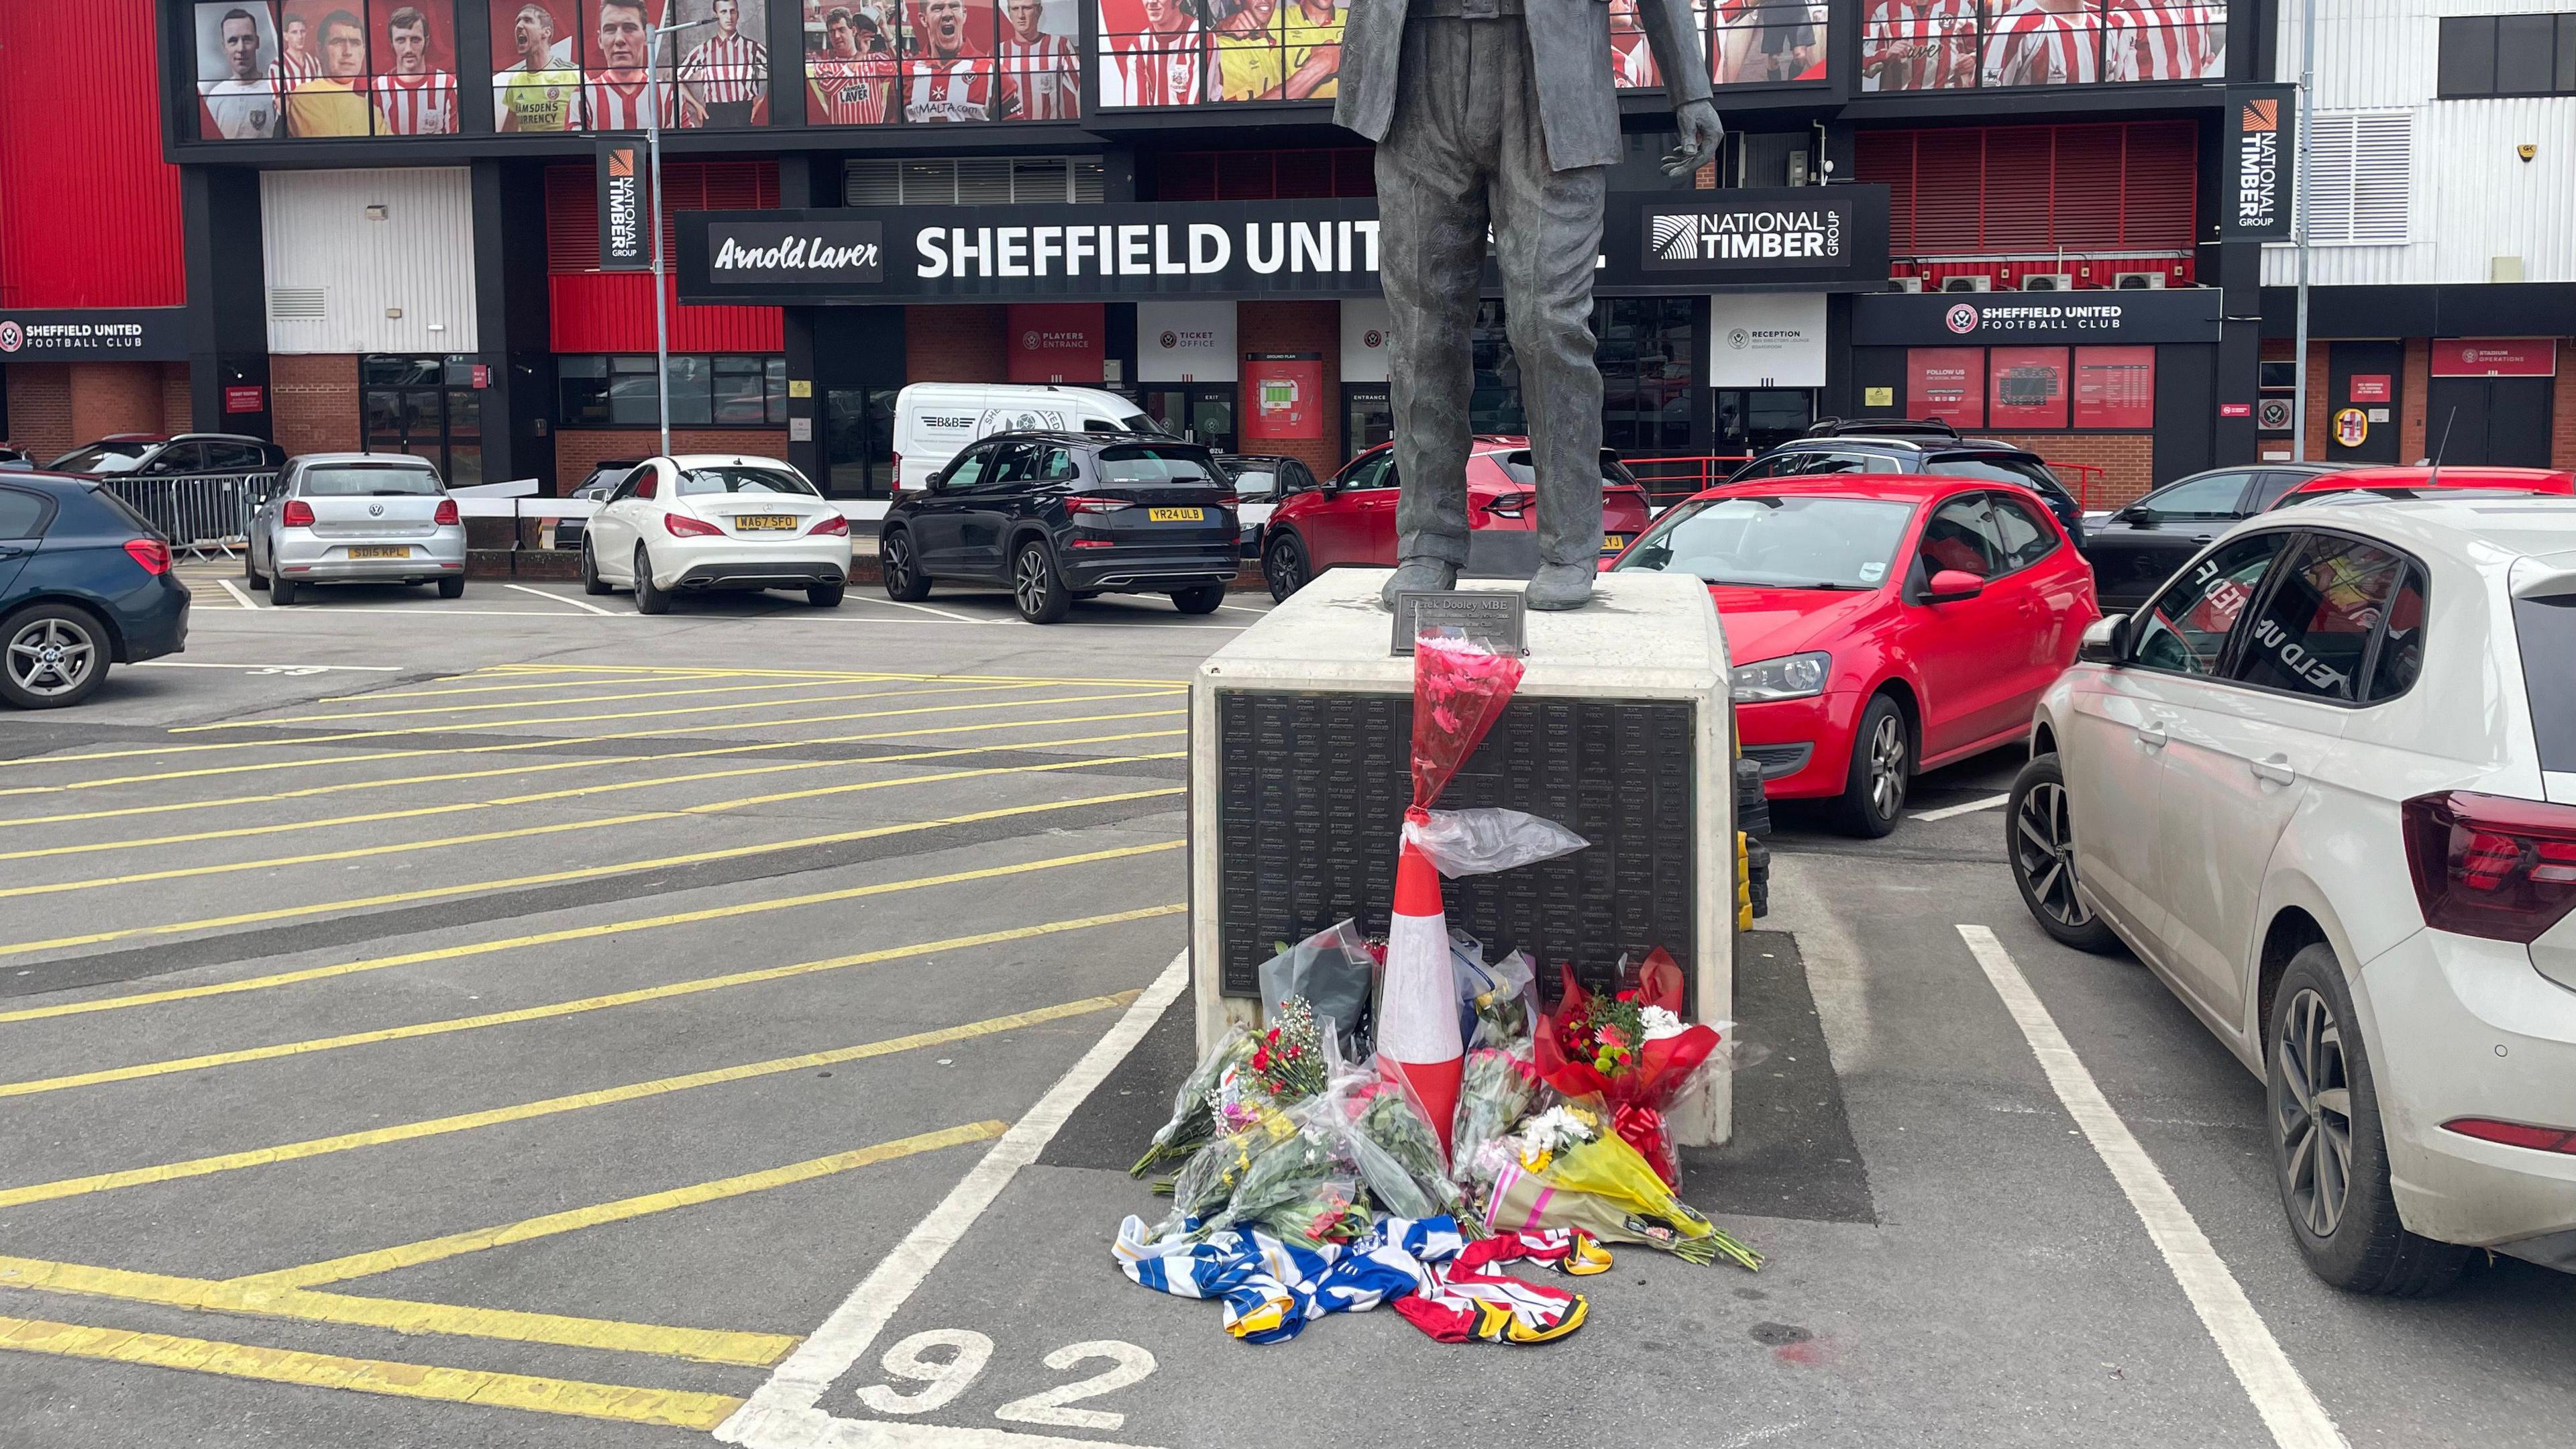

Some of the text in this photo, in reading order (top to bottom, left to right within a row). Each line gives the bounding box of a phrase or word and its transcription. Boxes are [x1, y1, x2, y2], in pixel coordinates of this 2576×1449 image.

[1907, 44, 1943, 58] aver
[843, 84, 865, 93] ARNOLD
[839, 91, 868, 103] LAVER
[2239, 132, 2261, 217] TIMBER
[2259, 131, 2277, 217] NATIONAL
[609, 177, 626, 249] TIMBER
[623, 177, 637, 249] NATIONAL
[1701, 211, 1825, 233] NATIONAL
[2239, 217, 2275, 227] GROUP
[1827, 210, 1840, 257] GROUP
[714, 235, 877, 270] Arnold Laver
[916, 220, 1380, 278] SHEFFIELD UNIT
[1701, 232, 1825, 260] TIMBER
[612, 249, 637, 257] GROUP
[1982, 306, 2123, 319] SHEFFIELD UNITED
[25, 323, 142, 337] SHEFFIELD UNITED
[1982, 319, 2121, 329] FOOTBALL CLUB
[27, 337, 142, 348] FOOTBALL CLUB
[937, 417, 959, 427] B&B
[1153, 508, 1200, 520] YR24 ULB
[741, 517, 769, 527] WA67
[382, 547, 405, 557] KPL
[1410, 599, 1508, 612] Derek Dooley MBE
[855, 1328, 1158, 1431] 92
